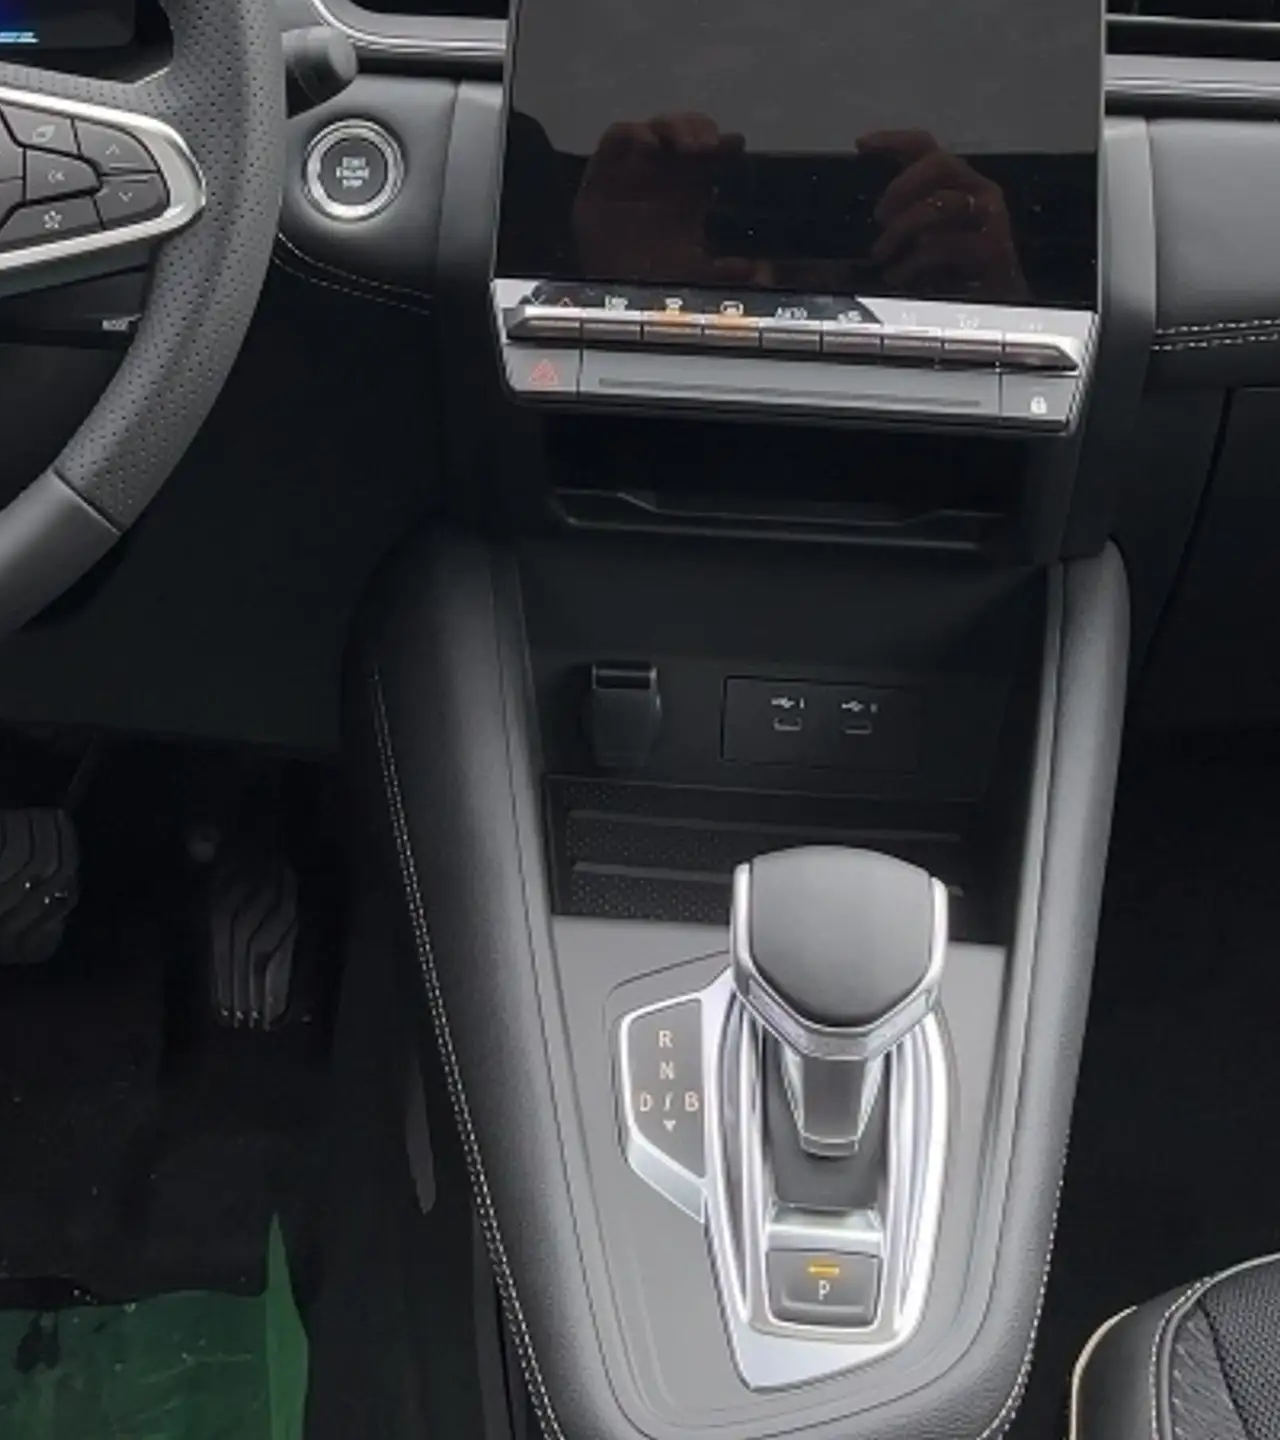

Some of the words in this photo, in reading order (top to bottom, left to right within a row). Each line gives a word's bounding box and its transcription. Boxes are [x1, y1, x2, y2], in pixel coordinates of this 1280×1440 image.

[658, 1029, 673, 1049] R
[660, 1060, 675, 1080] N
[639, 1091, 654, 1112] D
[684, 1091, 700, 1112] B
[818, 1279, 831, 1301] P
